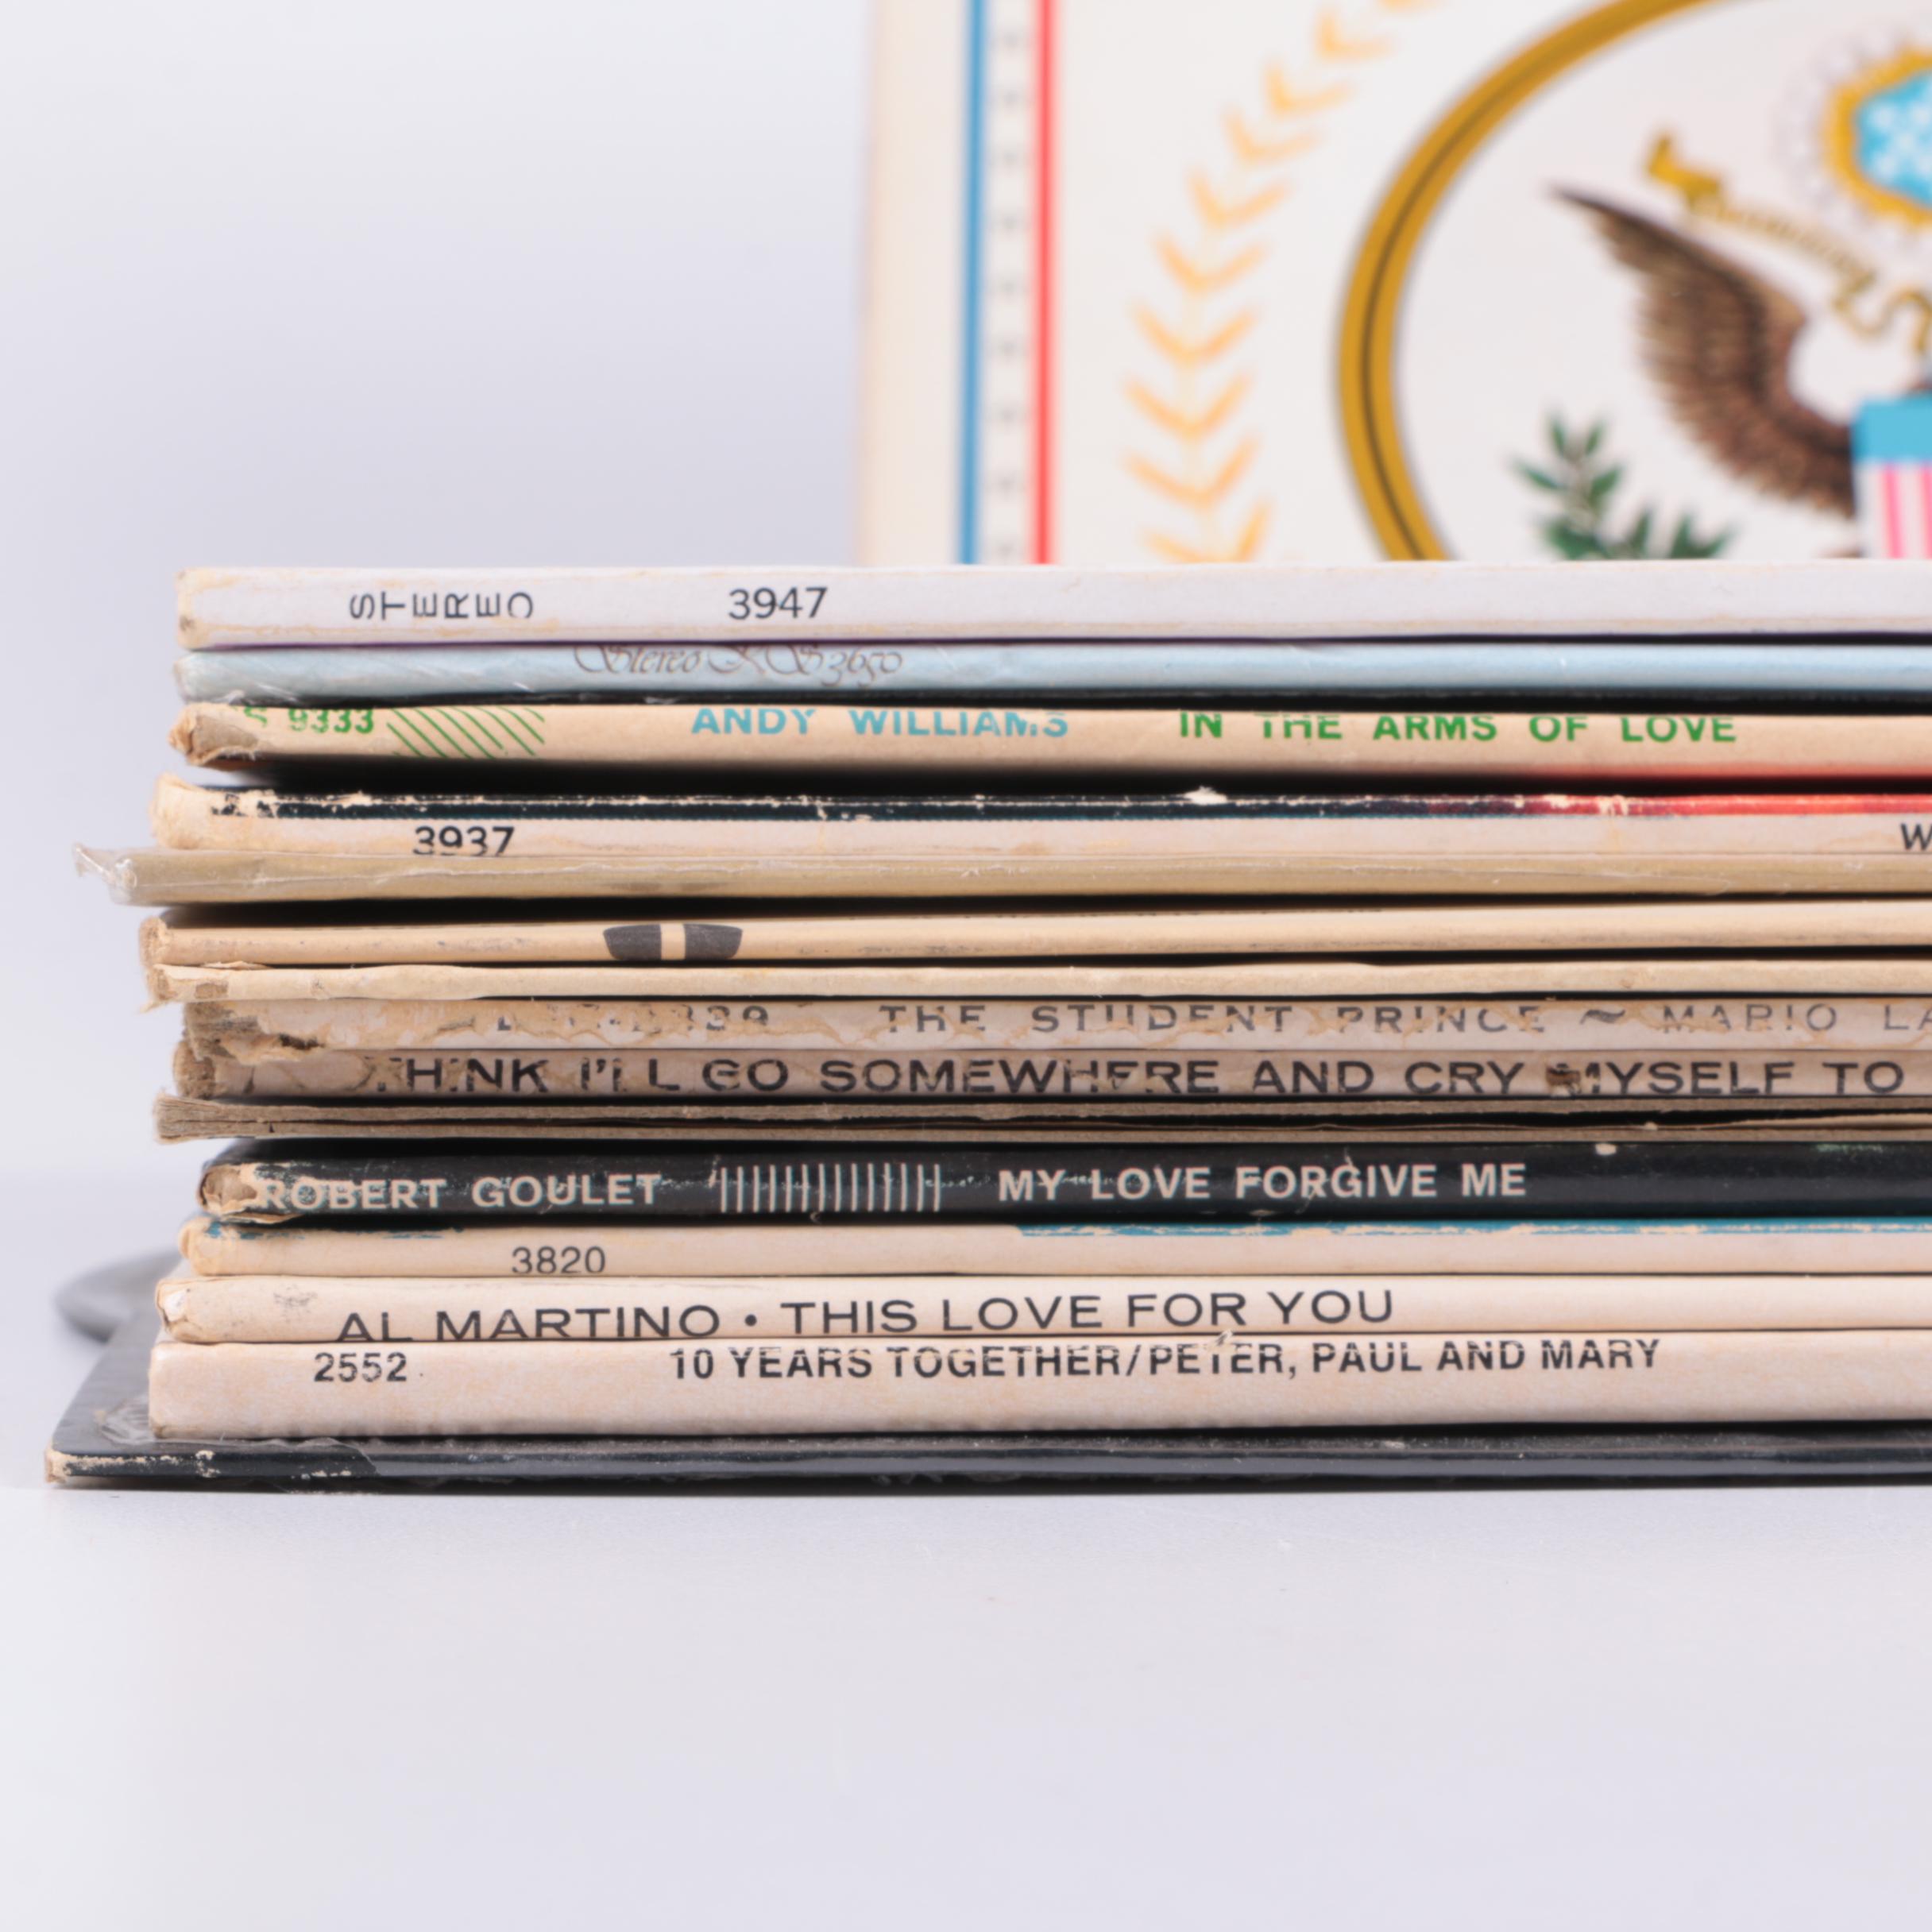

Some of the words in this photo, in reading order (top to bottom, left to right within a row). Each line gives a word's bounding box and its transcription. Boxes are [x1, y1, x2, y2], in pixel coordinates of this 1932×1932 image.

[349, 592, 534, 620] STEREO
[728, 587, 828, 620] 3947
[288, 708, 374, 734] 9333
[691, 708, 817, 735] ANDY
[848, 709, 1068, 737] WILLIAMS
[1179, 711, 1223, 738] IN
[1253, 712, 1343, 740] THE
[1372, 714, 1498, 741] ARMS
[1528, 715, 1589, 743] OF
[1619, 716, 1737, 743] LOVE
[412, 825, 516, 856] 3937
[879, 1004, 986, 1033] THE
[701, 1057, 789, 1093] GO
[820, 1058, 1220, 1095] SOMEWHERE
[1252, 1060, 1375, 1095] AND
[1404, 1061, 1526, 1095] CRY
[1821, 1061, 1905, 1095] TO
[259, 1177, 448, 1209] ROBERT
[472, 1173, 663, 1208] GOULET
[998, 1169, 1065, 1201] MY
[1092, 1166, 1211, 1200] LOVE
[1235, 1164, 1439, 1199] FORGIVE
[1461, 1163, 1527, 1197] ME
[511, 1246, 606, 1274] 3820
[335, 1312, 413, 1343] AL
[435, 1304, 721, 1342] MARTINO
[780, 1299, 918, 1335] THIS
[942, 1296, 1103, 1331] LOVE
[1126, 1293, 1247, 1328] FOR
[1266, 1289, 1393, 1325] YOU
[313, 1352, 408, 1383] 2552
[670, 1348, 715, 1380] 10
[728, 1346, 874, 1379] YEARS
[1312, 1343, 1423, 1374] PAUL
[1435, 1340, 1526, 1372] AND
[1540, 1339, 1660, 1370] MARY
